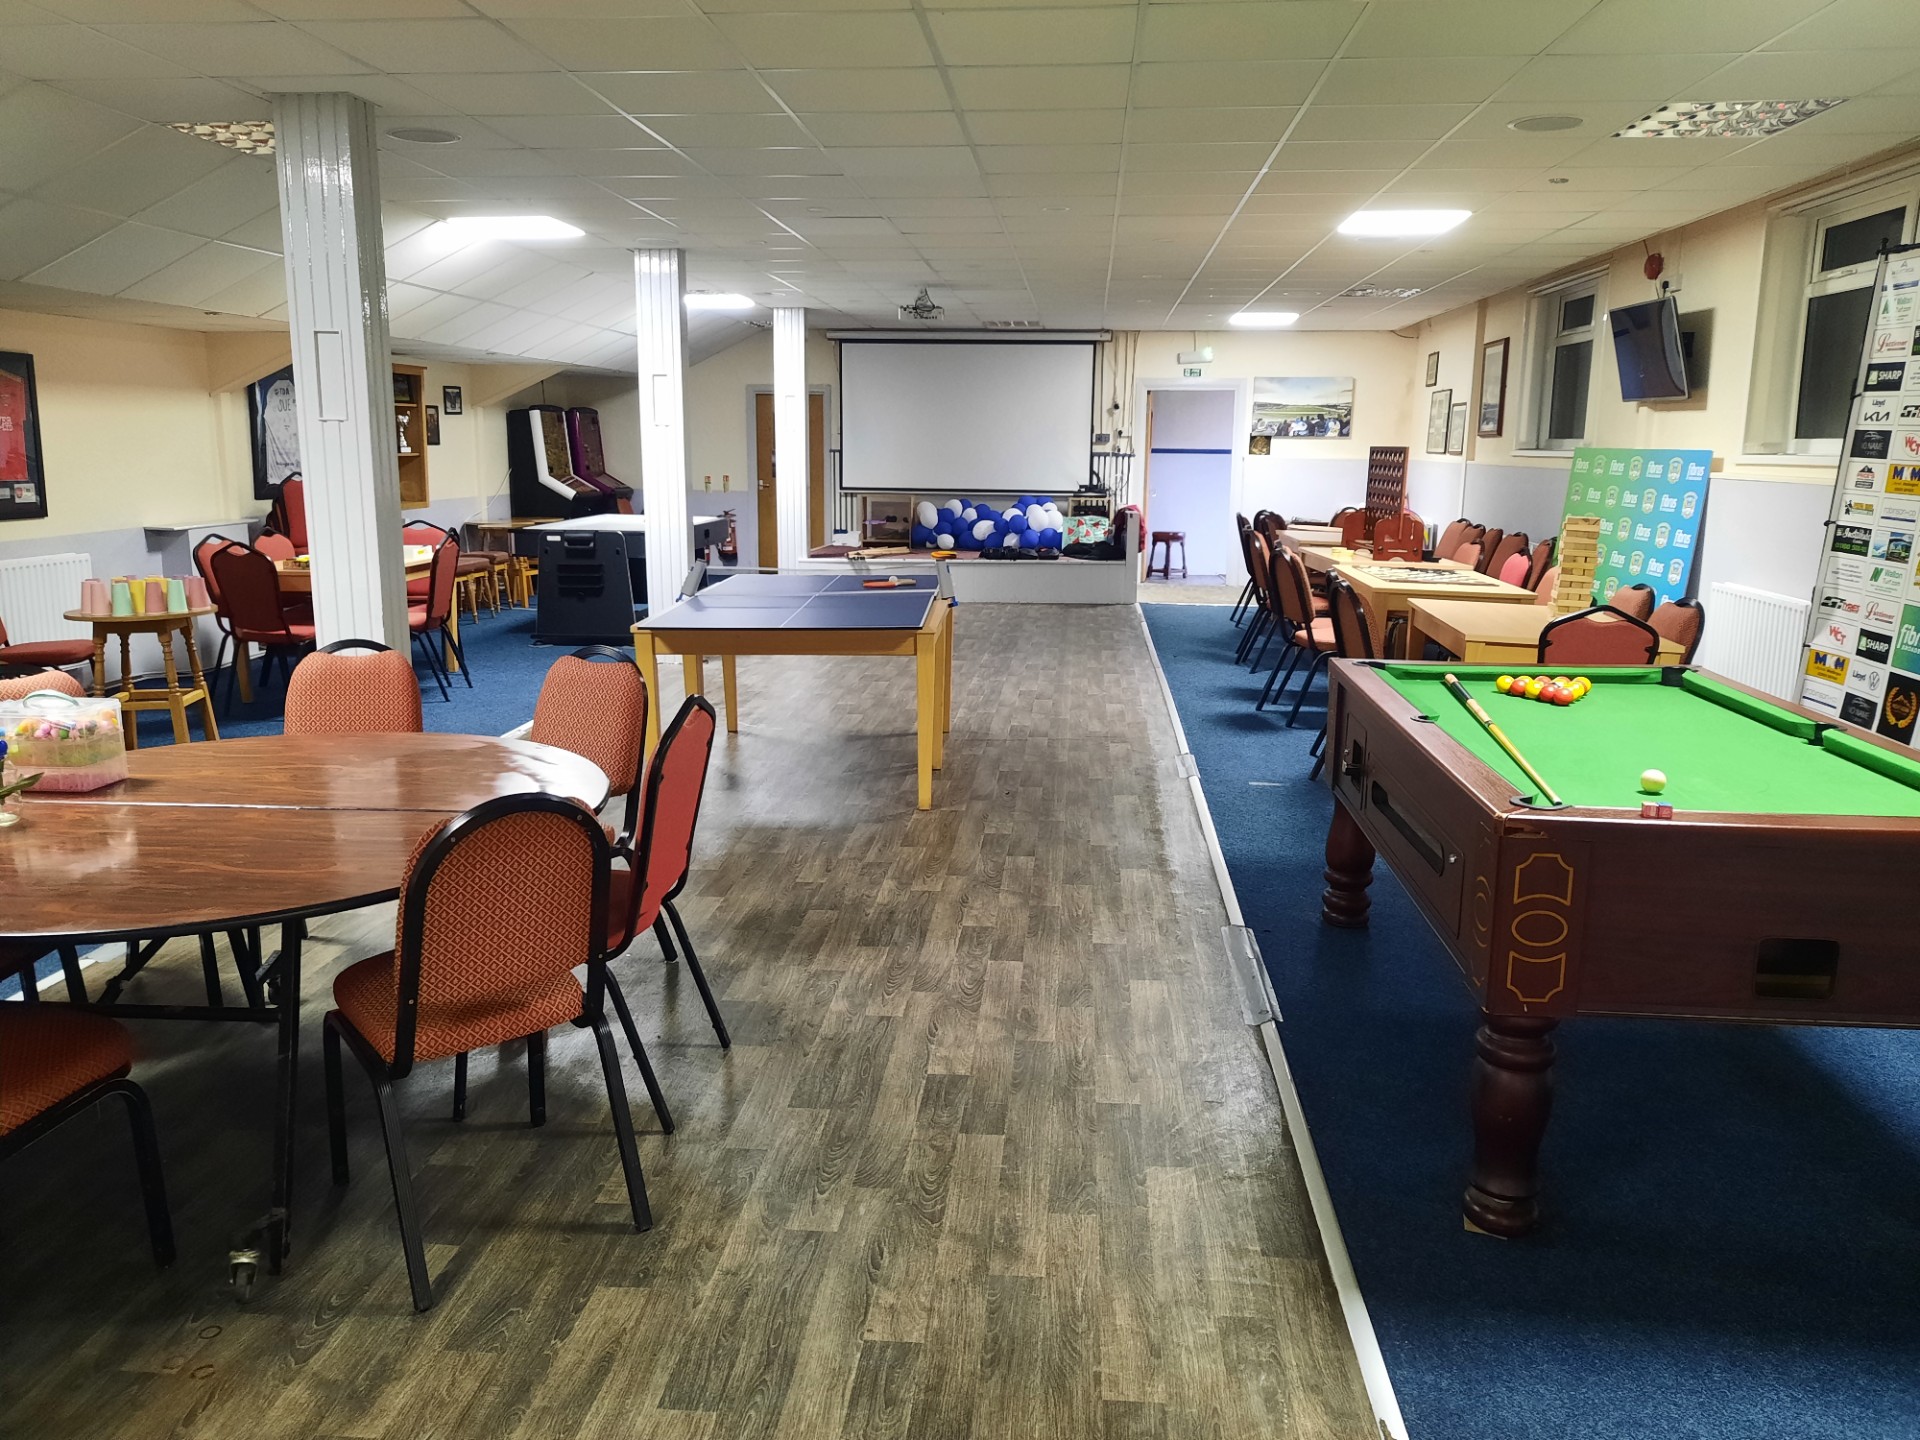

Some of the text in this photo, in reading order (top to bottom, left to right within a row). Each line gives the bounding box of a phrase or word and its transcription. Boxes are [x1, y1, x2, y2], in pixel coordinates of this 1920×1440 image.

[1878, 370, 1902, 380] SHARP
[1866, 639, 1889, 653] SHARP
[1852, 669, 1867, 681] Lloyd
